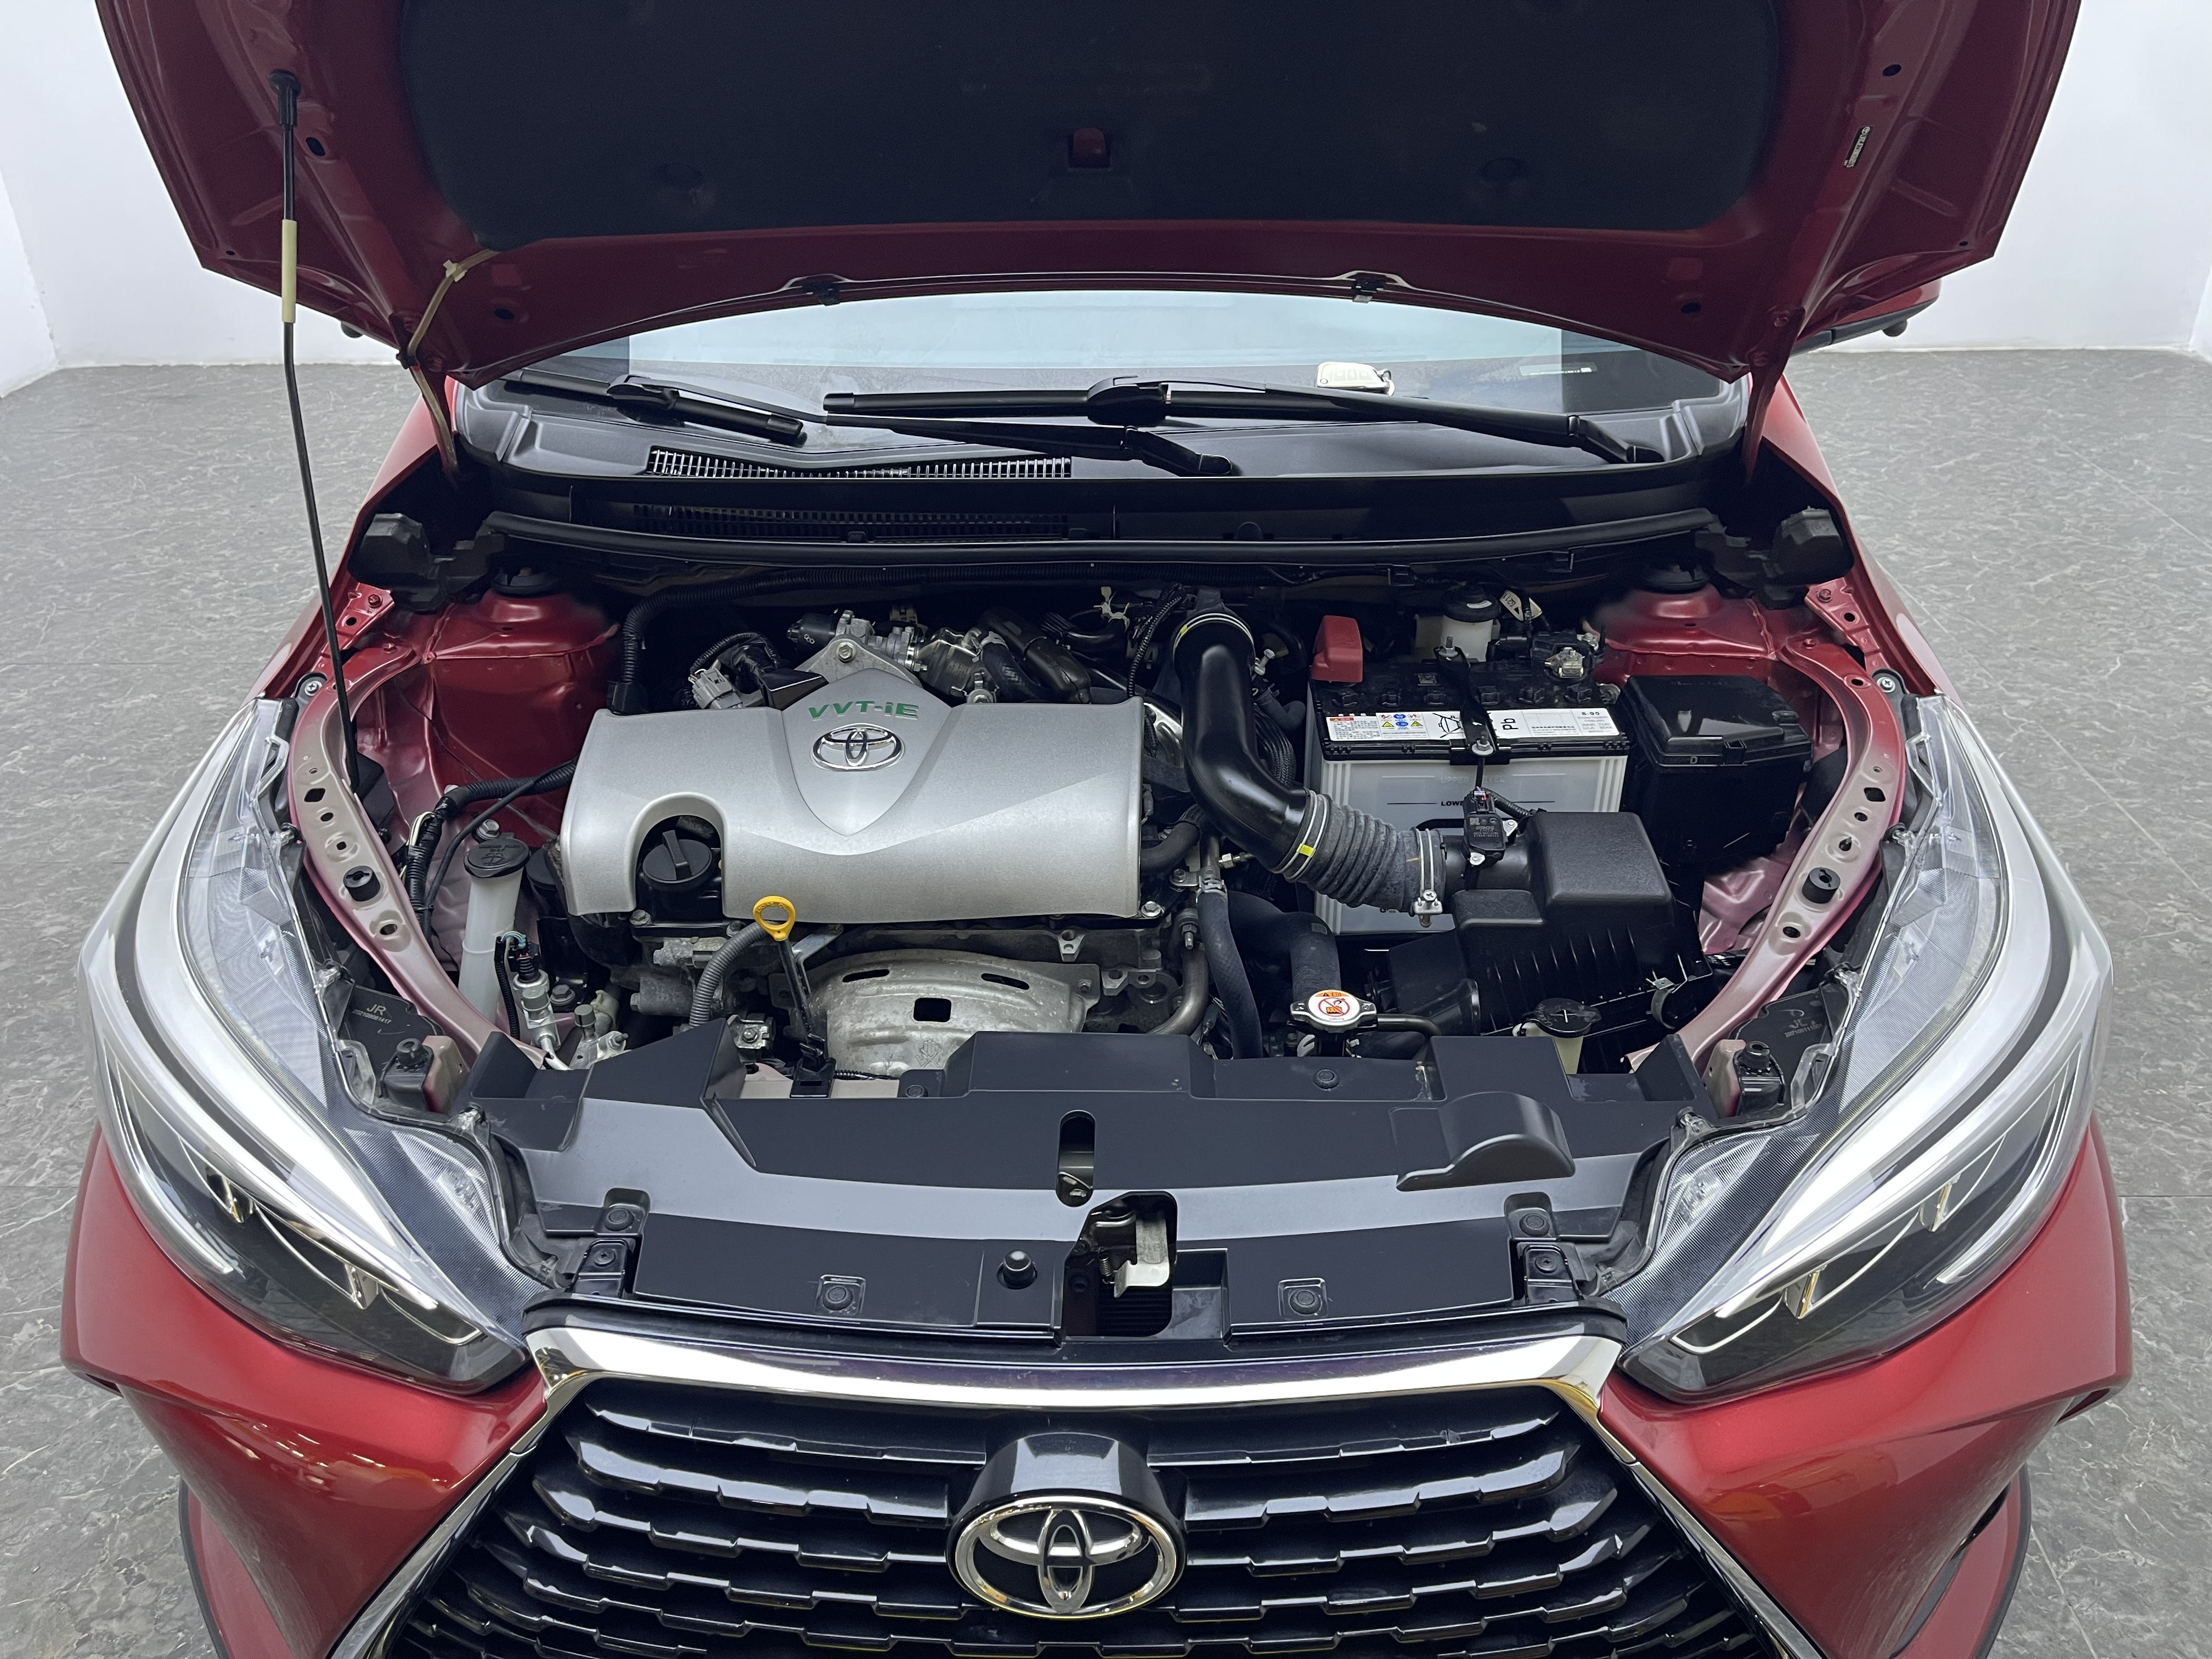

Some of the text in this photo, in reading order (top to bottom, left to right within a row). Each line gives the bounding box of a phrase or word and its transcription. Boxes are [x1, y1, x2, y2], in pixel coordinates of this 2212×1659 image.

[1503, 594, 1516, 607] 6211
[808, 701, 919, 721] VVT-iE
[1500, 718, 1519, 730] Pb
[366, 1004, 386, 1016] JR
